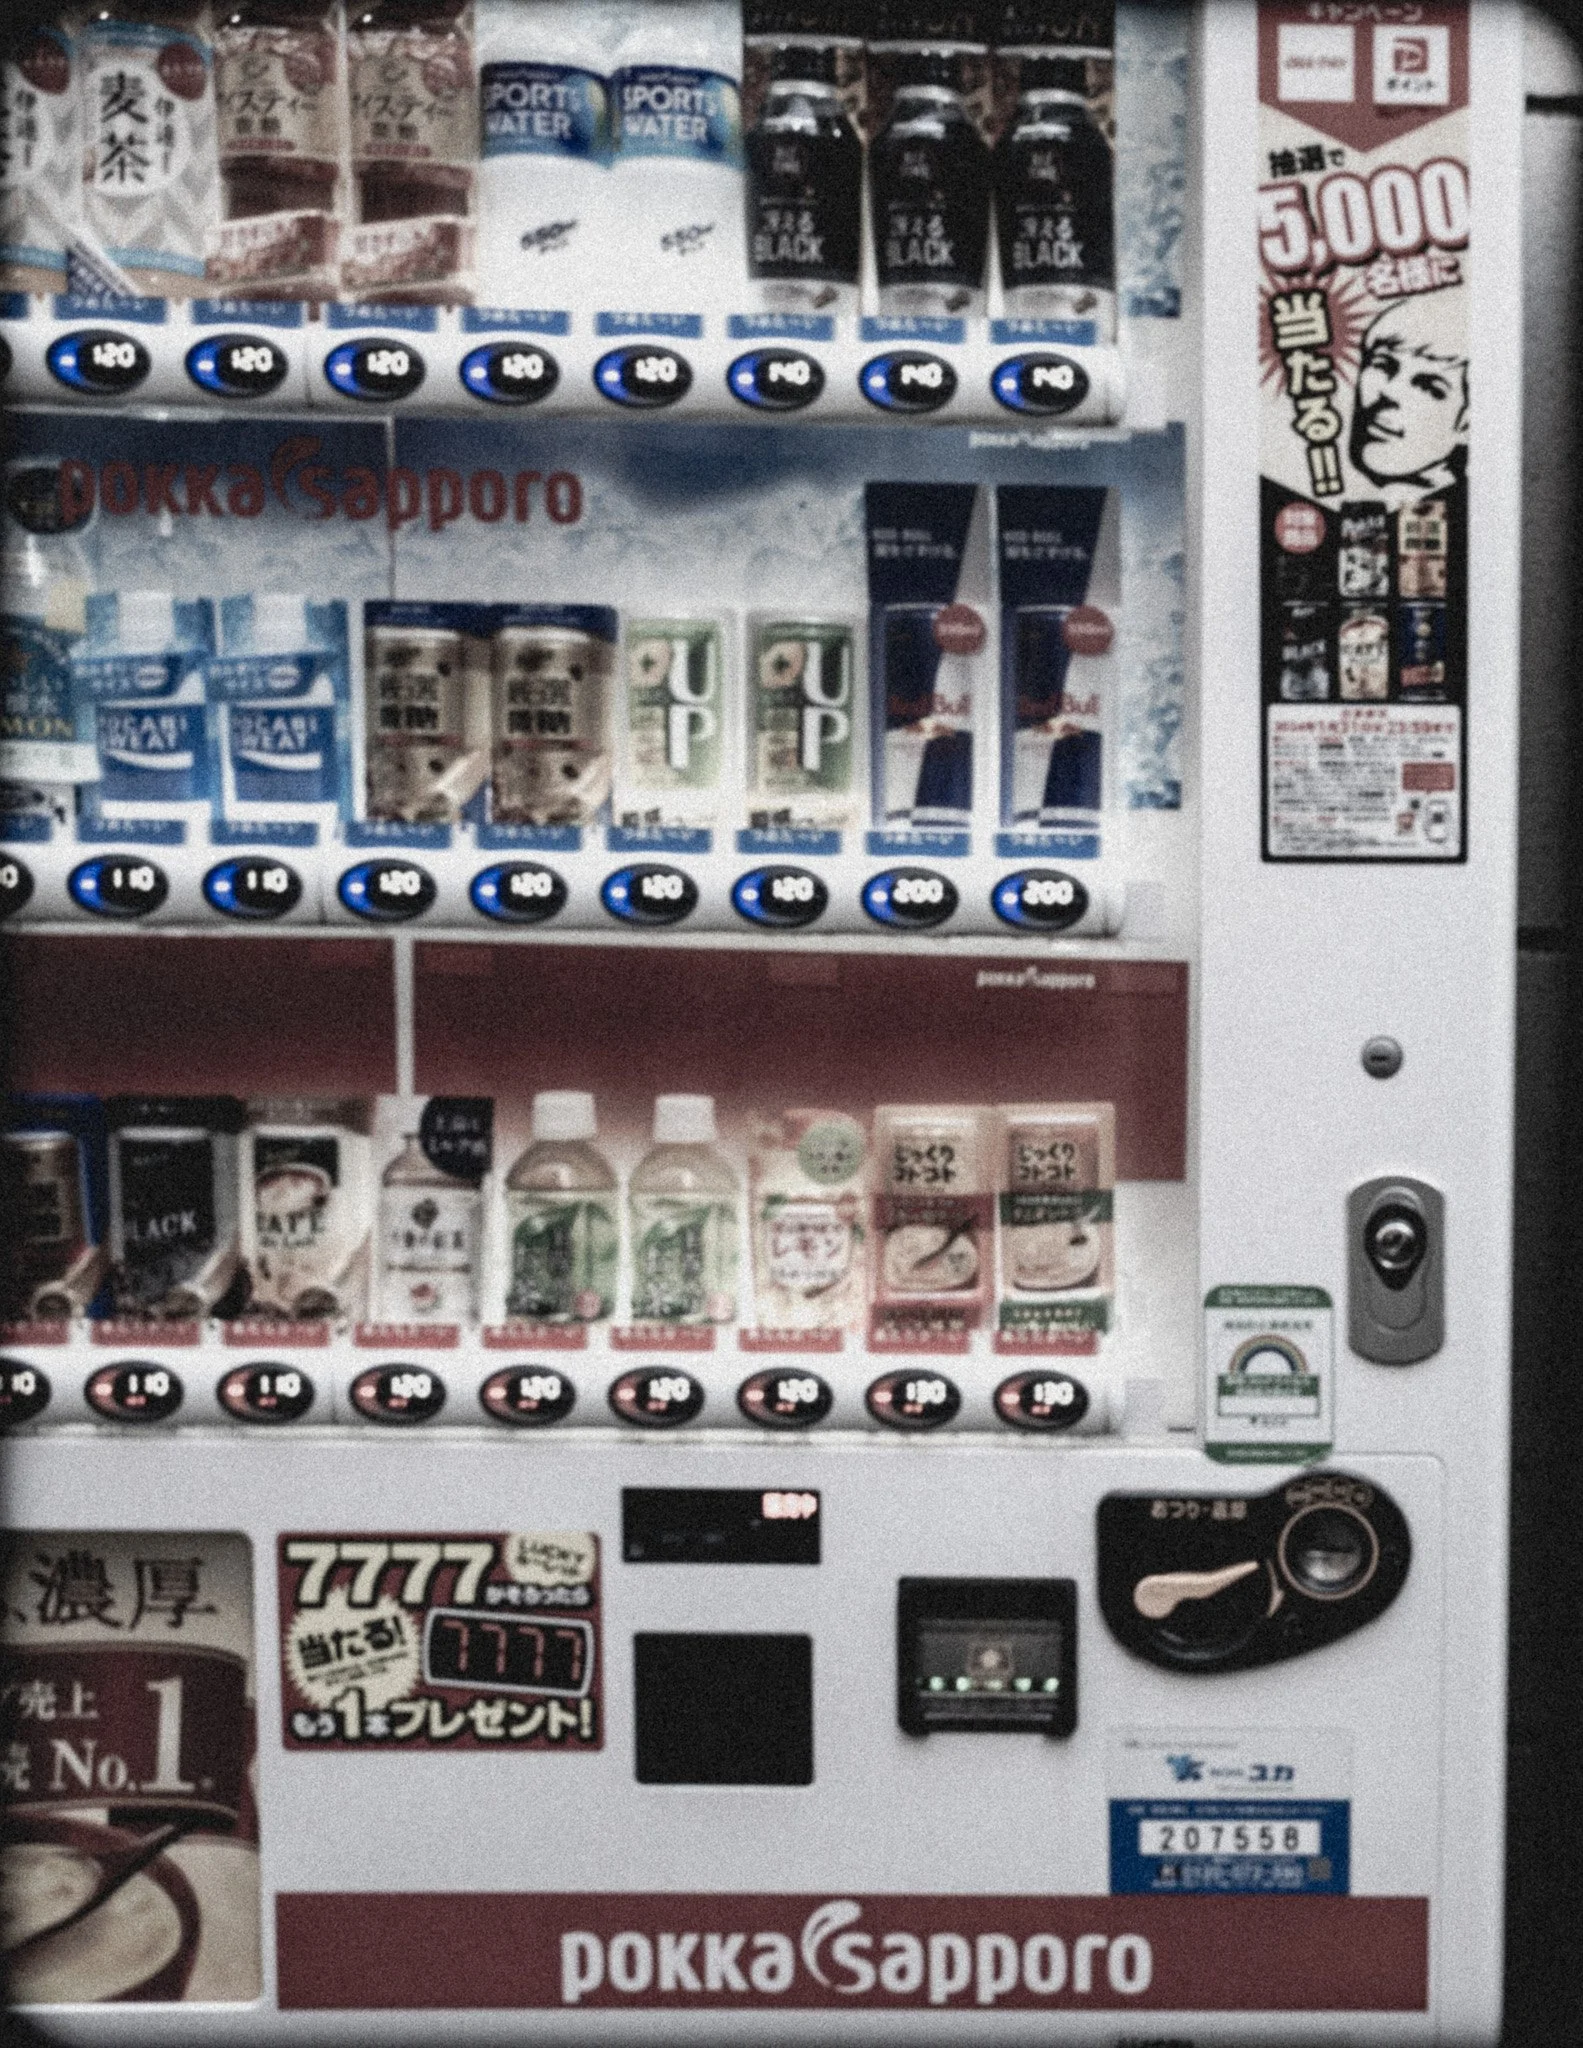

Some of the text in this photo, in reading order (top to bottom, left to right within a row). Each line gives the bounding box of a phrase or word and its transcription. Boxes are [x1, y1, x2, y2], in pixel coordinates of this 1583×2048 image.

[101, 70, 151, 184] 麦茶
[623, 115, 707, 142] WATER
[1258, 156, 1470, 276] 5,000
[753, 235, 826, 263] BLACK
[885, 239, 955, 267] BLACK
[1011, 242, 1085, 270] BLACK
[93, 342, 135, 367] 120
[232, 347, 273, 372] 120
[368, 350, 409, 375] 120
[503, 354, 543, 379] 120
[636, 357, 677, 382] 120
[769, 360, 810, 385] 140
[901, 362, 942, 387] 140
[1033, 364, 1074, 390] 140
[0, 716, 75, 738] MON
[114, 866, 154, 891] 110
[248, 867, 288, 892] 110
[380, 870, 420, 895] 120
[511, 872, 552, 897] 120
[643, 874, 683, 899] 120
[773, 876, 814, 901] 120
[893, 878, 943, 903] 200
[1023, 879, 1073, 905] 200
[128, 1209, 198, 1243] LACK
[0, 1371, 35, 1395] 10
[128, 1372, 169, 1396] 110
[260, 1373, 301, 1398] 110
[286, 1541, 495, 1605] 7777
[28, 1549, 217, 1629] 濃厚
[2, 1681, 98, 1720] 売上
[1159, 1825, 1300, 1852] 207558
[830, 1930, 1153, 2005] sapporo
